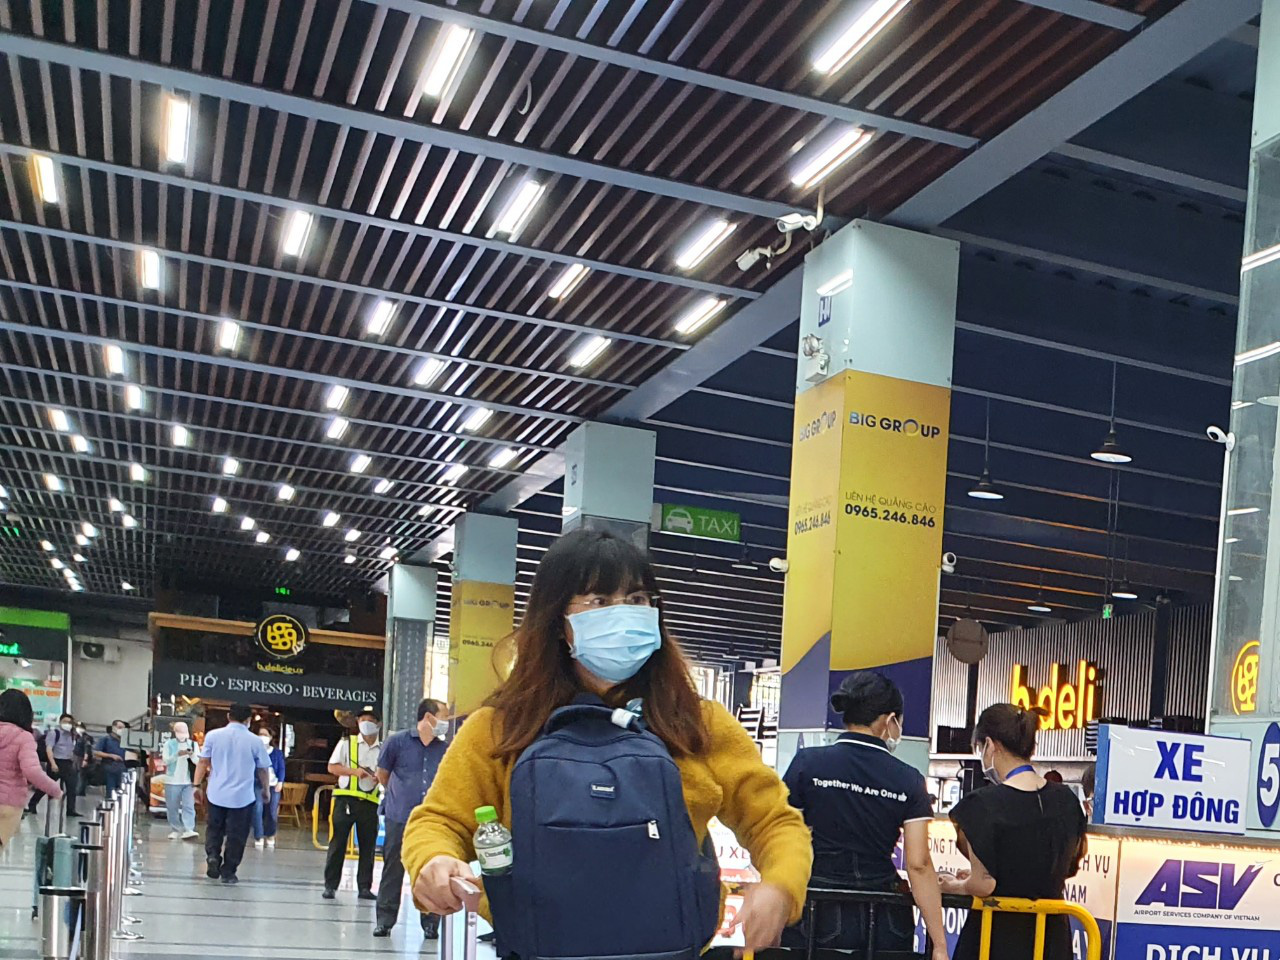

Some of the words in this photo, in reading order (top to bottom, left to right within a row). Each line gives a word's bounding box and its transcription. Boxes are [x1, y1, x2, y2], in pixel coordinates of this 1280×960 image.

[849, 411, 877, 428] BIG
[879, 416, 941, 439] GROUP
[845, 491, 864, 503] LIÊN
[697, 515, 738, 536] TAXI
[844, 503, 936, 528] 0965.246.846
[228, 678, 293, 696] ESPRESSO
[302, 685, 378, 703] BEVERAGES
[1153, 740, 1205, 783] XE
[1260, 743, 1280, 807] 5
[812, 777, 851, 790] Together
[851, 783, 863, 794] We
[864, 786, 879, 796] Are
[880, 788, 898, 801] One
[1112, 789, 1165, 822] HỢP
[1134, 858, 1264, 911] ASV
[1134, 909, 1162, 917] AIRPORT
[1163, 910, 1192, 918] SERVICES
[1193, 912, 1223, 920] COMPANY
[1233, 914, 1261, 922] VIETNAM
